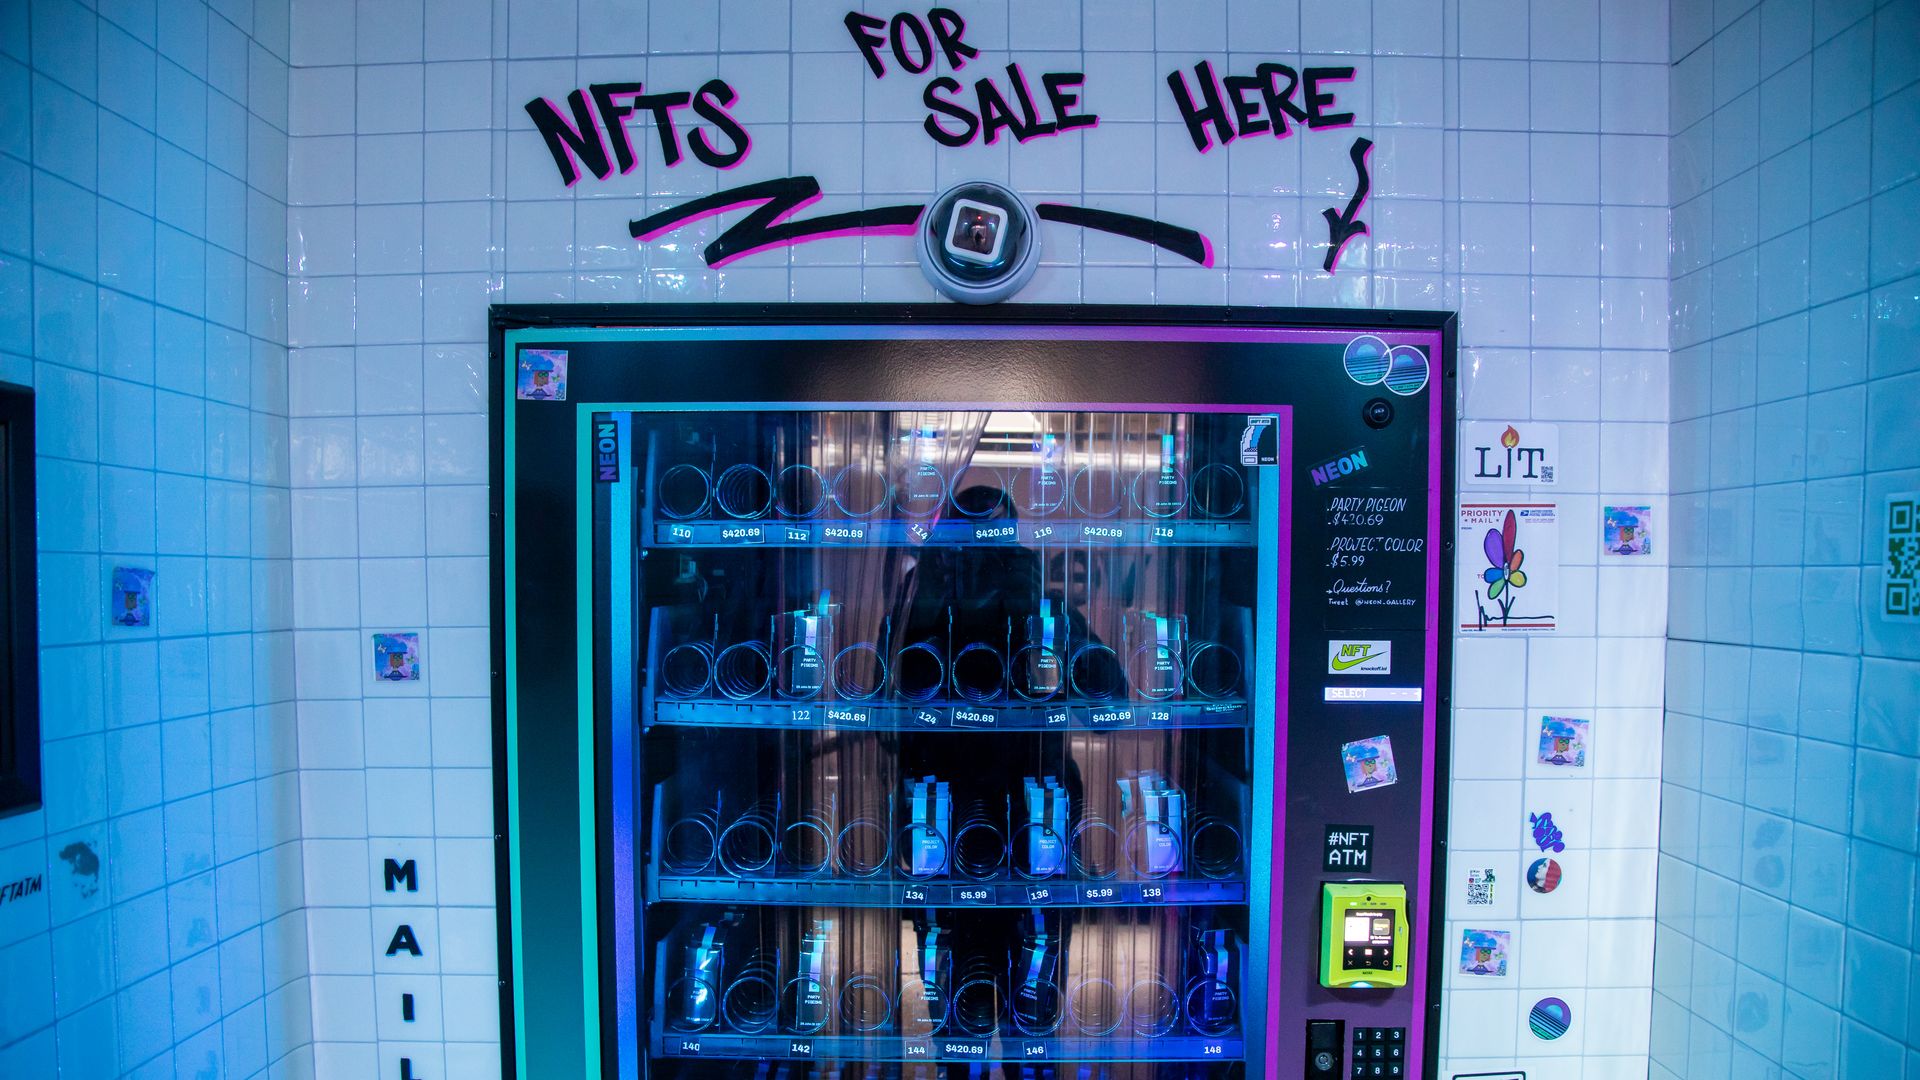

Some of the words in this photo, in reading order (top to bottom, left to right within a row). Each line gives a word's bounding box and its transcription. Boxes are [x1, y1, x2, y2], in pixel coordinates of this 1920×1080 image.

[525, 79, 752, 188] NFTS
[843, 7, 982, 79] FOR
[922, 62, 1100, 149] SALE
[1167, 60, 1357, 153] HERE
[599, 423, 616, 481] NEON
[1310, 450, 1369, 487] NEON
[1330, 497, 1364, 512] PARTY
[1365, 498, 1408, 512] PIGEON
[1332, 513, 1384, 526] $420.69
[672, 527, 691, 539] 110
[722, 527, 760, 539] $420.69
[788, 531, 807, 541] 112
[825, 527, 864, 539] $420.69
[910, 523, 928, 540] 114
[976, 527, 1015, 539] $420.69
[1033, 526, 1053, 539] 116
[1084, 527, 1123, 538] $420.69
[1154, 527, 1174, 538] 118
[1330, 537, 1384, 552] PROJECT
[1384, 538, 1424, 552] COLOR
[1331, 552, 1365, 568] $5.99
[1333, 577, 1392, 594] Questions?
[1328, 598, 1348, 606] Tweet
[1341, 644, 1371, 657] NFT
[1332, 688, 1367, 698] SELECT
[792, 710, 810, 721] 122
[828, 710, 867, 723] $420.69
[918, 711, 937, 725] 124
[956, 711, 995, 723] $420.69
[1048, 713, 1066, 723] 126
[1092, 711, 1131, 723] $420.69
[1151, 711, 1169, 721] 128
[1328, 831, 1370, 846] #NFT
[1328, 849, 1367, 866] ATM
[905, 890, 924, 901] 134
[960, 890, 987, 900] $5.99
[1030, 889, 1049, 900] 136
[1086, 888, 1113, 899] $5.99
[1142, 888, 1161, 897] 138
[1358, 1031, 1363, 1039] 1
[1375, 1031, 1382, 1039] 2
[1393, 1031, 1400, 1039] 3
[682, 1041, 700, 1052] 140
[791, 1043, 810, 1054] 142
[907, 1046, 926, 1055] 144
[945, 1044, 983, 1054] $420.69
[1026, 1046, 1044, 1055] 146
[1204, 1045, 1222, 1054] 148
[1357, 1049, 1363, 1057] 4
[1375, 1049, 1381, 1057] 5
[1393, 1048, 1399, 1056] 6
[1356, 1067, 1363, 1075] 7
[1393, 1066, 1399, 1074] 9
